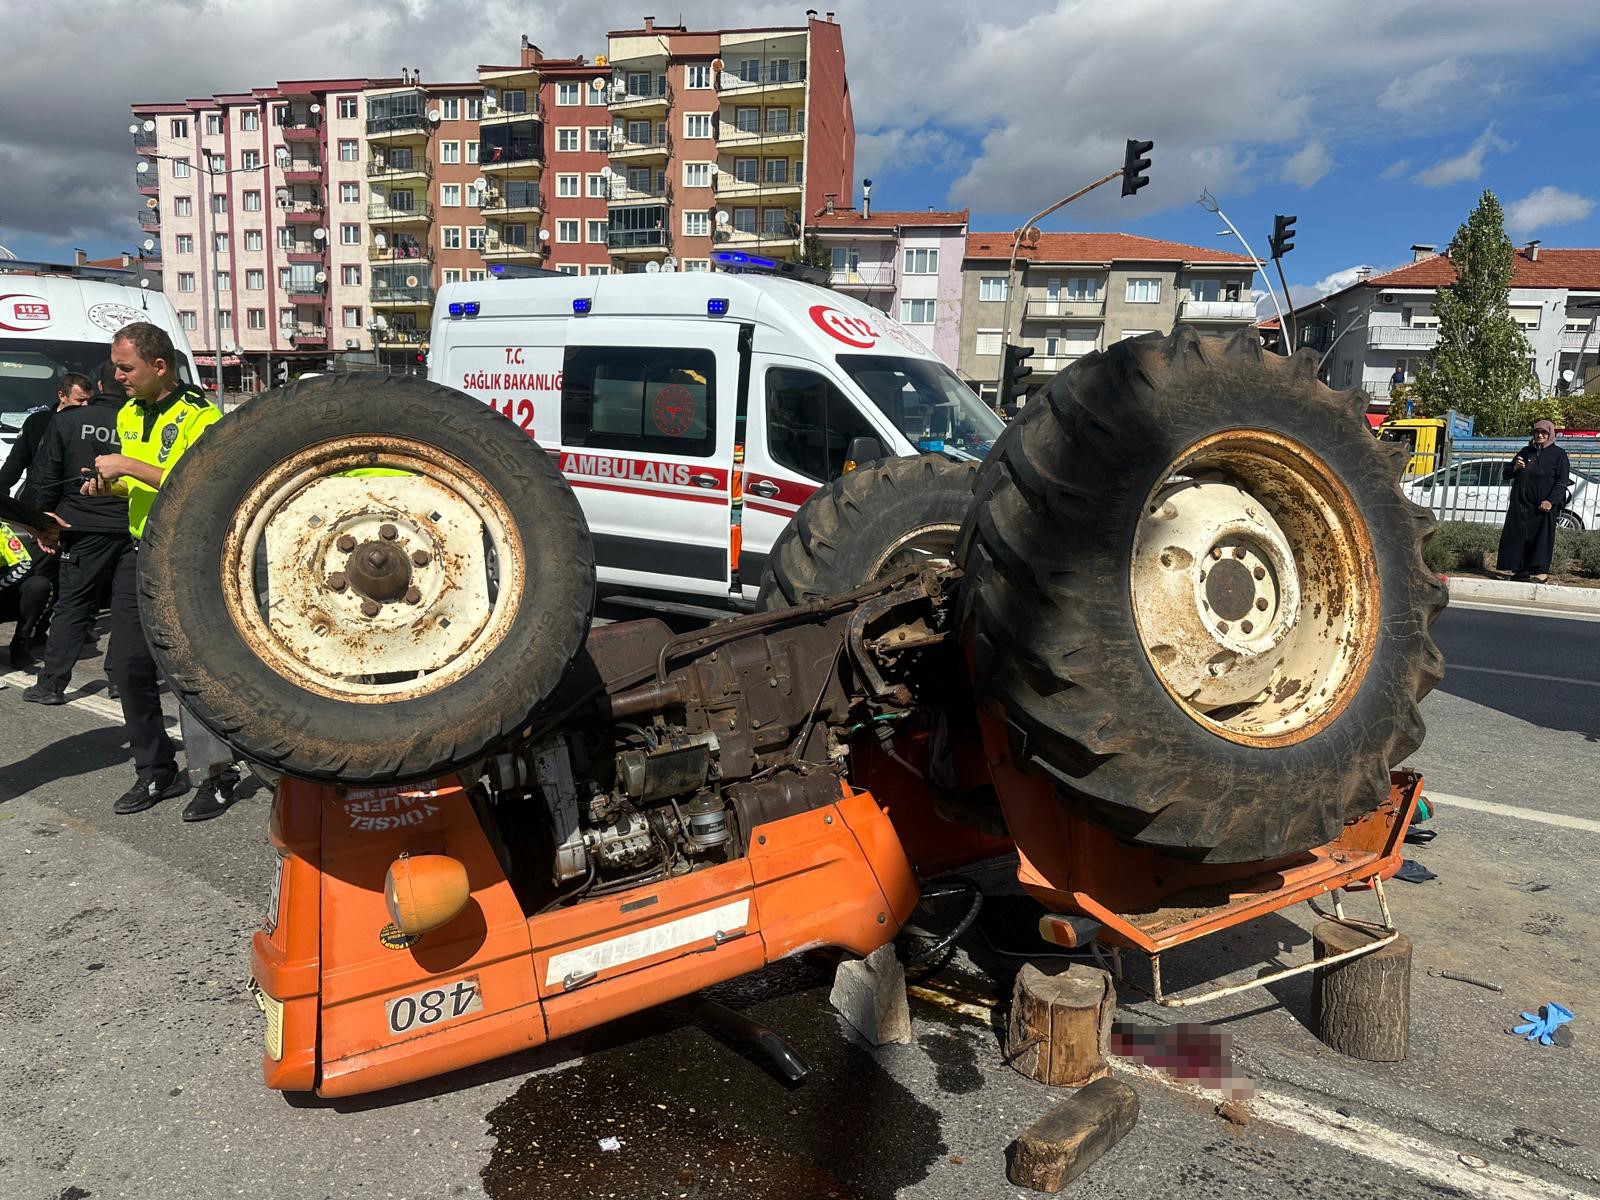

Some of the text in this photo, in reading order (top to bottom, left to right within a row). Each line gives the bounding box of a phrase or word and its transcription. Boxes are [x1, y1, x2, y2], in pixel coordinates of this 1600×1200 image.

[18, 304, 45, 314] 112
[831, 315, 880, 338] 112
[505, 347, 525, 365] T.C.
[463, 369, 563, 391] SAĞLIK BAKANLIĞ
[81, 424, 120, 446] POL
[563, 453, 690, 485] AMBULANS
[349, 803, 440, 831] YÜKSEL
[389, 981, 478, 1033] 480
